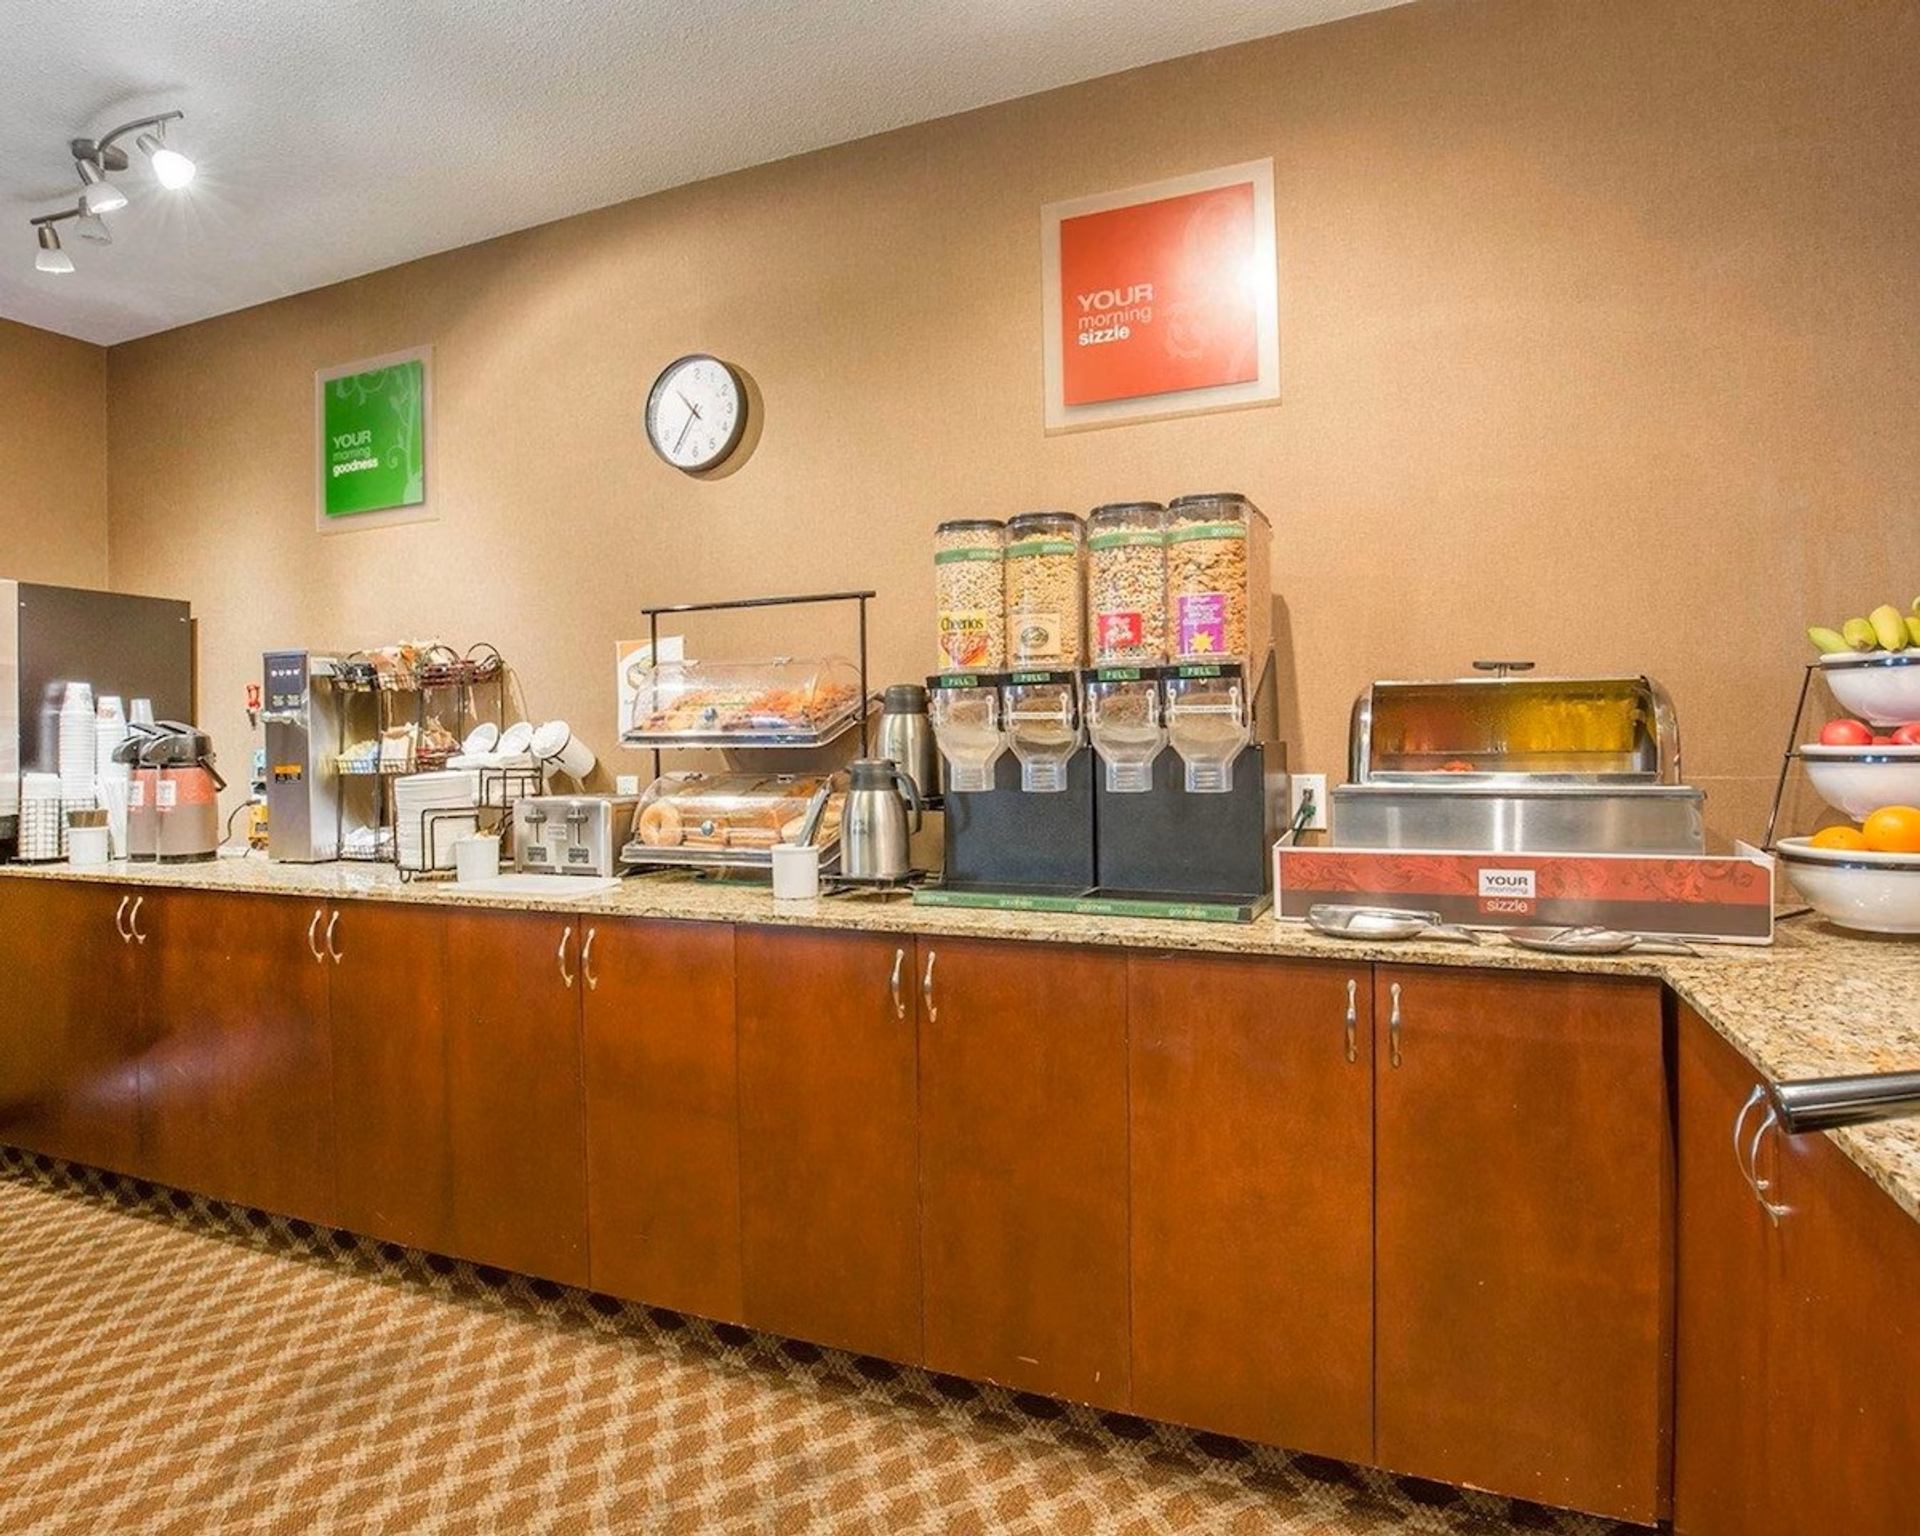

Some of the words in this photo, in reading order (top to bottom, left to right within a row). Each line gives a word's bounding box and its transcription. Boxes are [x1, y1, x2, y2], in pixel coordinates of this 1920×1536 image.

[1077, 283, 1153, 312] YOUR
[1078, 306, 1152, 330] morning
[1078, 325, 1131, 346] sizzle
[332, 430, 372, 449] YOUR
[940, 616, 984, 632] Cheerios
[1105, 670, 1128, 679] PULL
[1187, 666, 1211, 676] PULL
[1486, 875, 1528, 887] YOUR
[1486, 898, 1528, 912] sizzle
